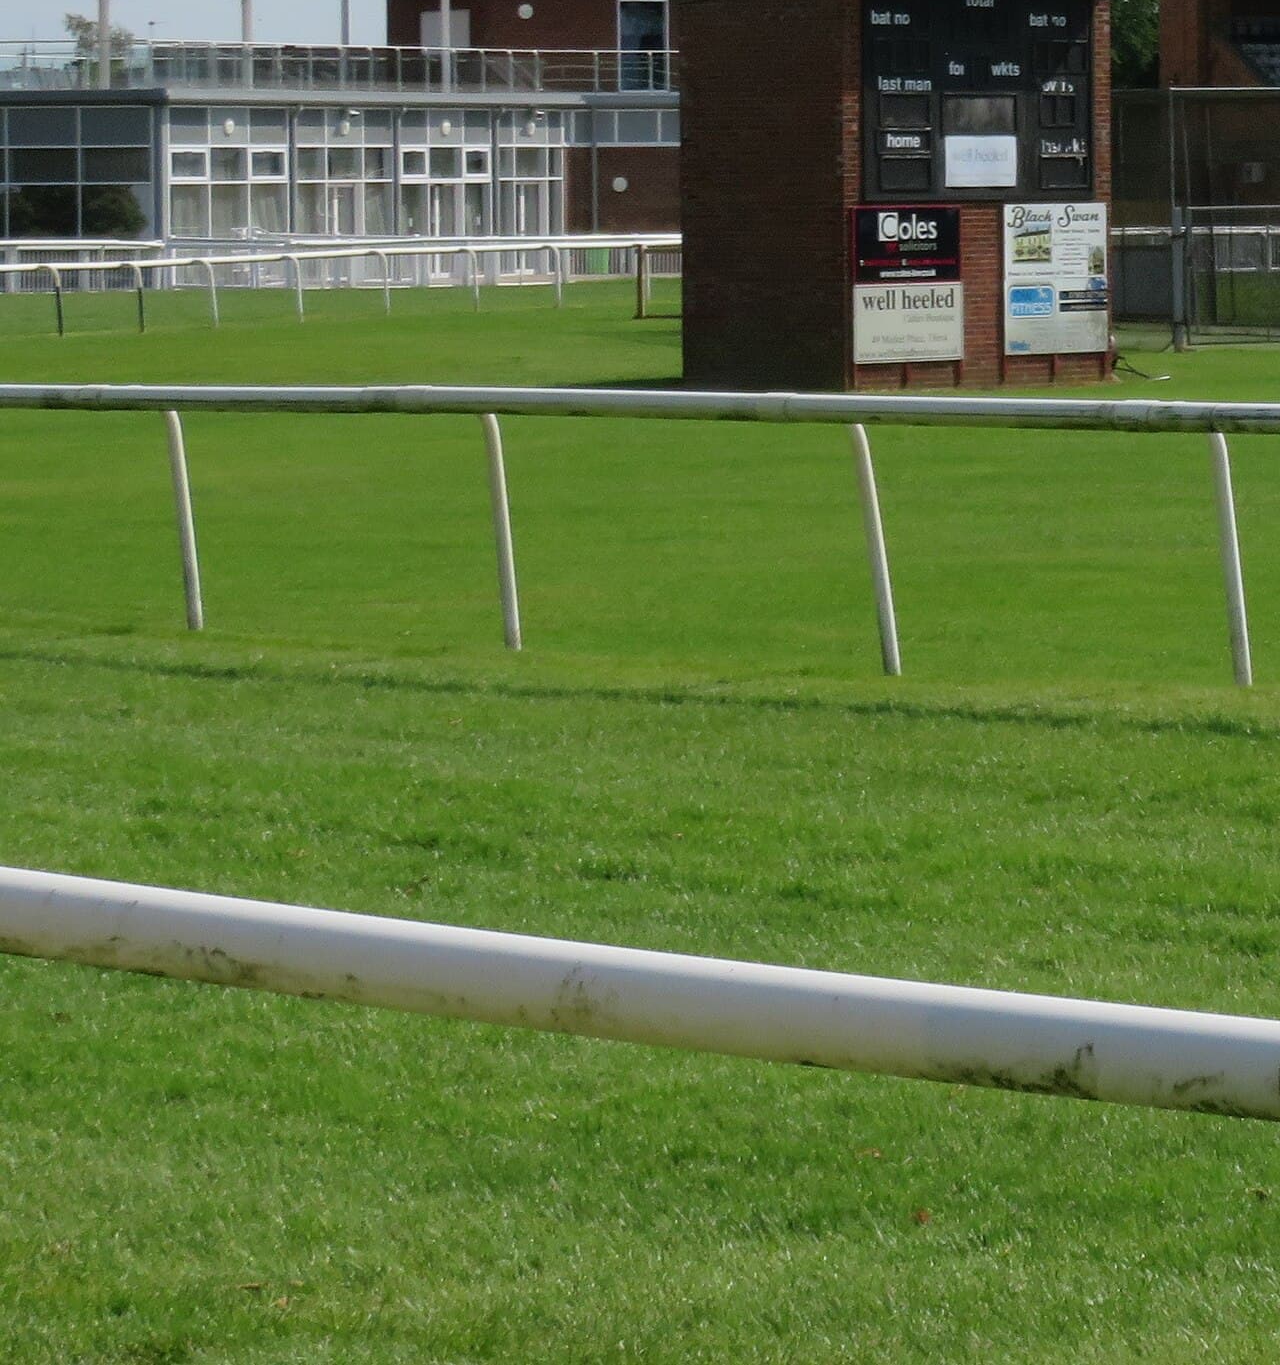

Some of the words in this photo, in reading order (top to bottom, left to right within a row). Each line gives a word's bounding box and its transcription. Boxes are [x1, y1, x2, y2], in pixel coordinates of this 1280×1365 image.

[871, 10, 891, 25] bat
[894, 14, 911, 25] no
[1029, 13, 1049, 27] bat
[991, 61, 1021, 76] wkts
[878, 76, 901, 91] last
[904, 79, 932, 91] man
[886, 134, 921, 148] home
[1007, 206, 1053, 228] Black
[1057, 205, 1099, 227] Swan
[879, 212, 938, 241] Coles
[899, 240, 938, 251] solicitors
[862, 289, 896, 311] well
[901, 287, 955, 310] heeled
